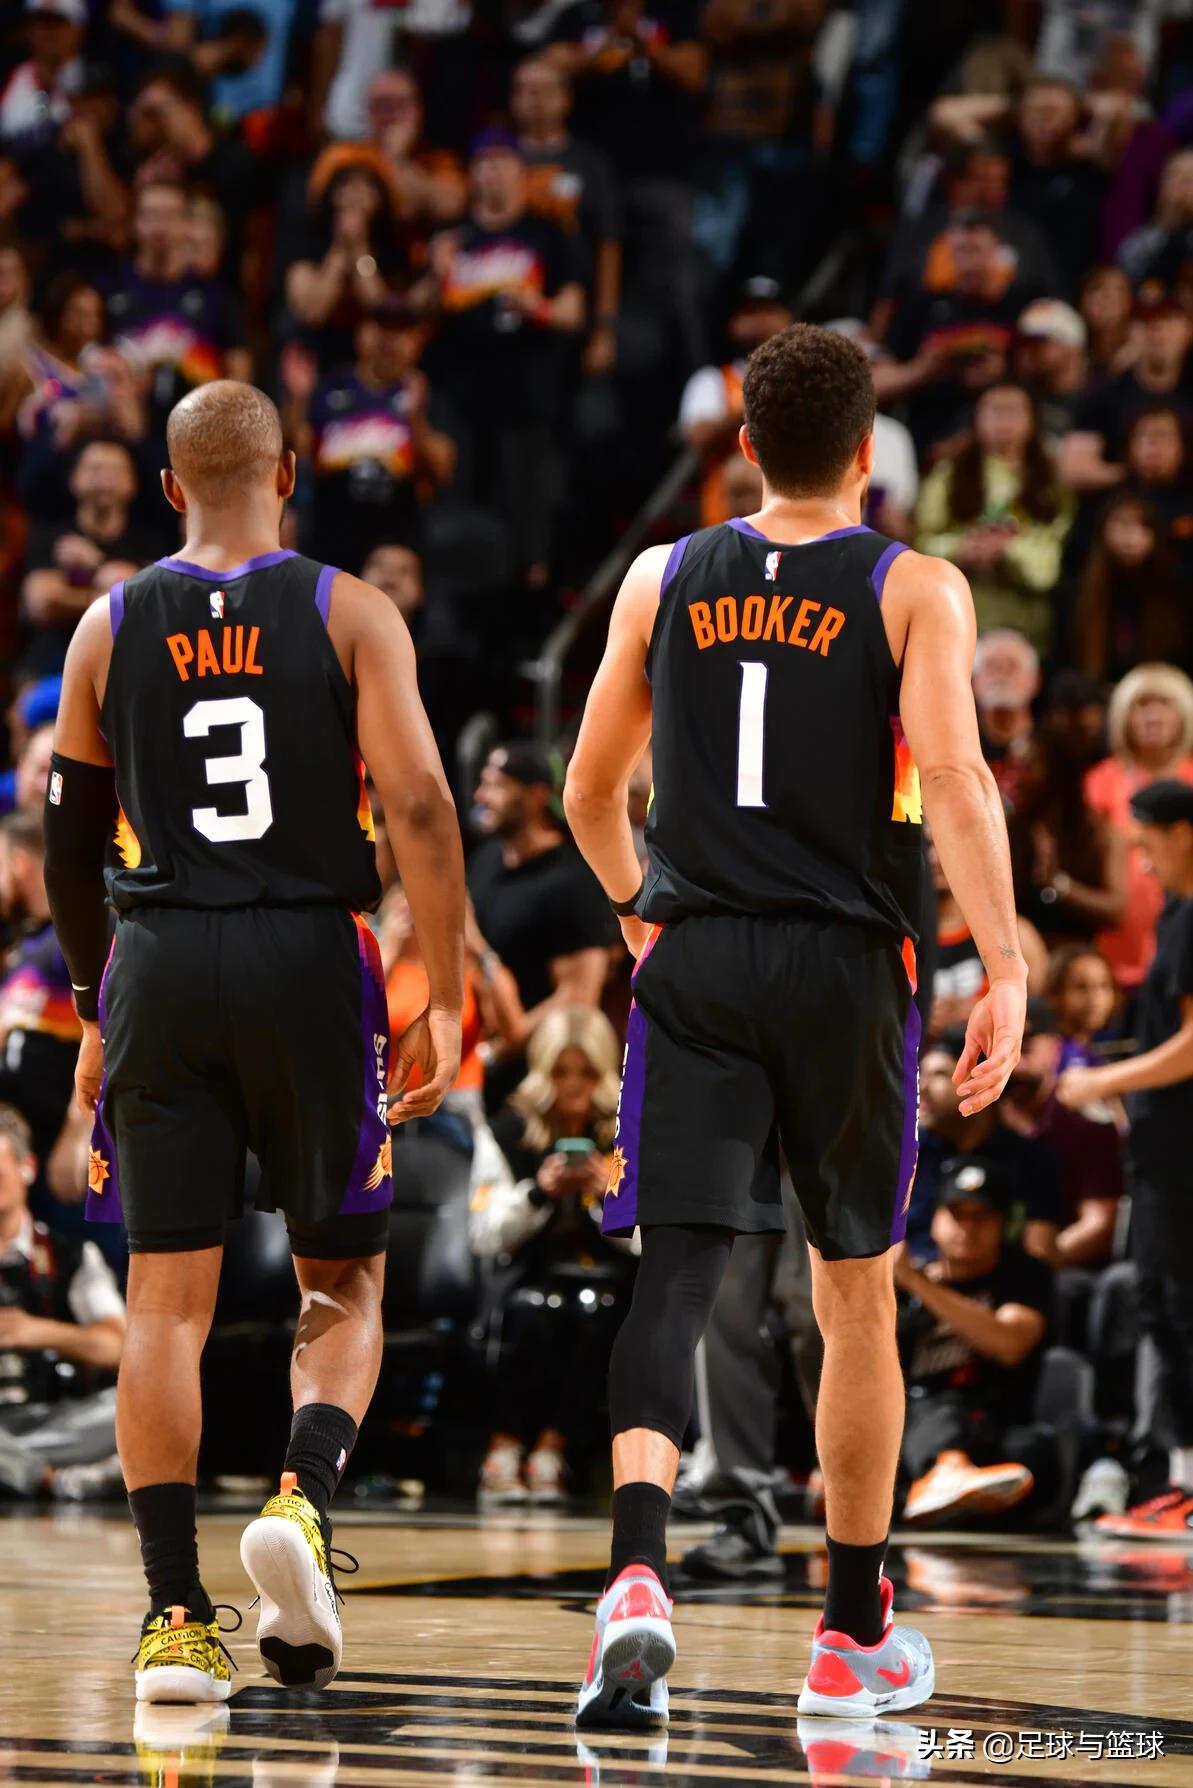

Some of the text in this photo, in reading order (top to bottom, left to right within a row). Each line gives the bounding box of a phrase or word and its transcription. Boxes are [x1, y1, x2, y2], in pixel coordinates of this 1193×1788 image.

[166, 625, 264, 682] PAUL
[688, 595, 846, 657] BOOKER
[737, 661, 768, 807] 1
[183, 697, 273, 842] 3
[161, 1629, 202, 1646] CAUTION
